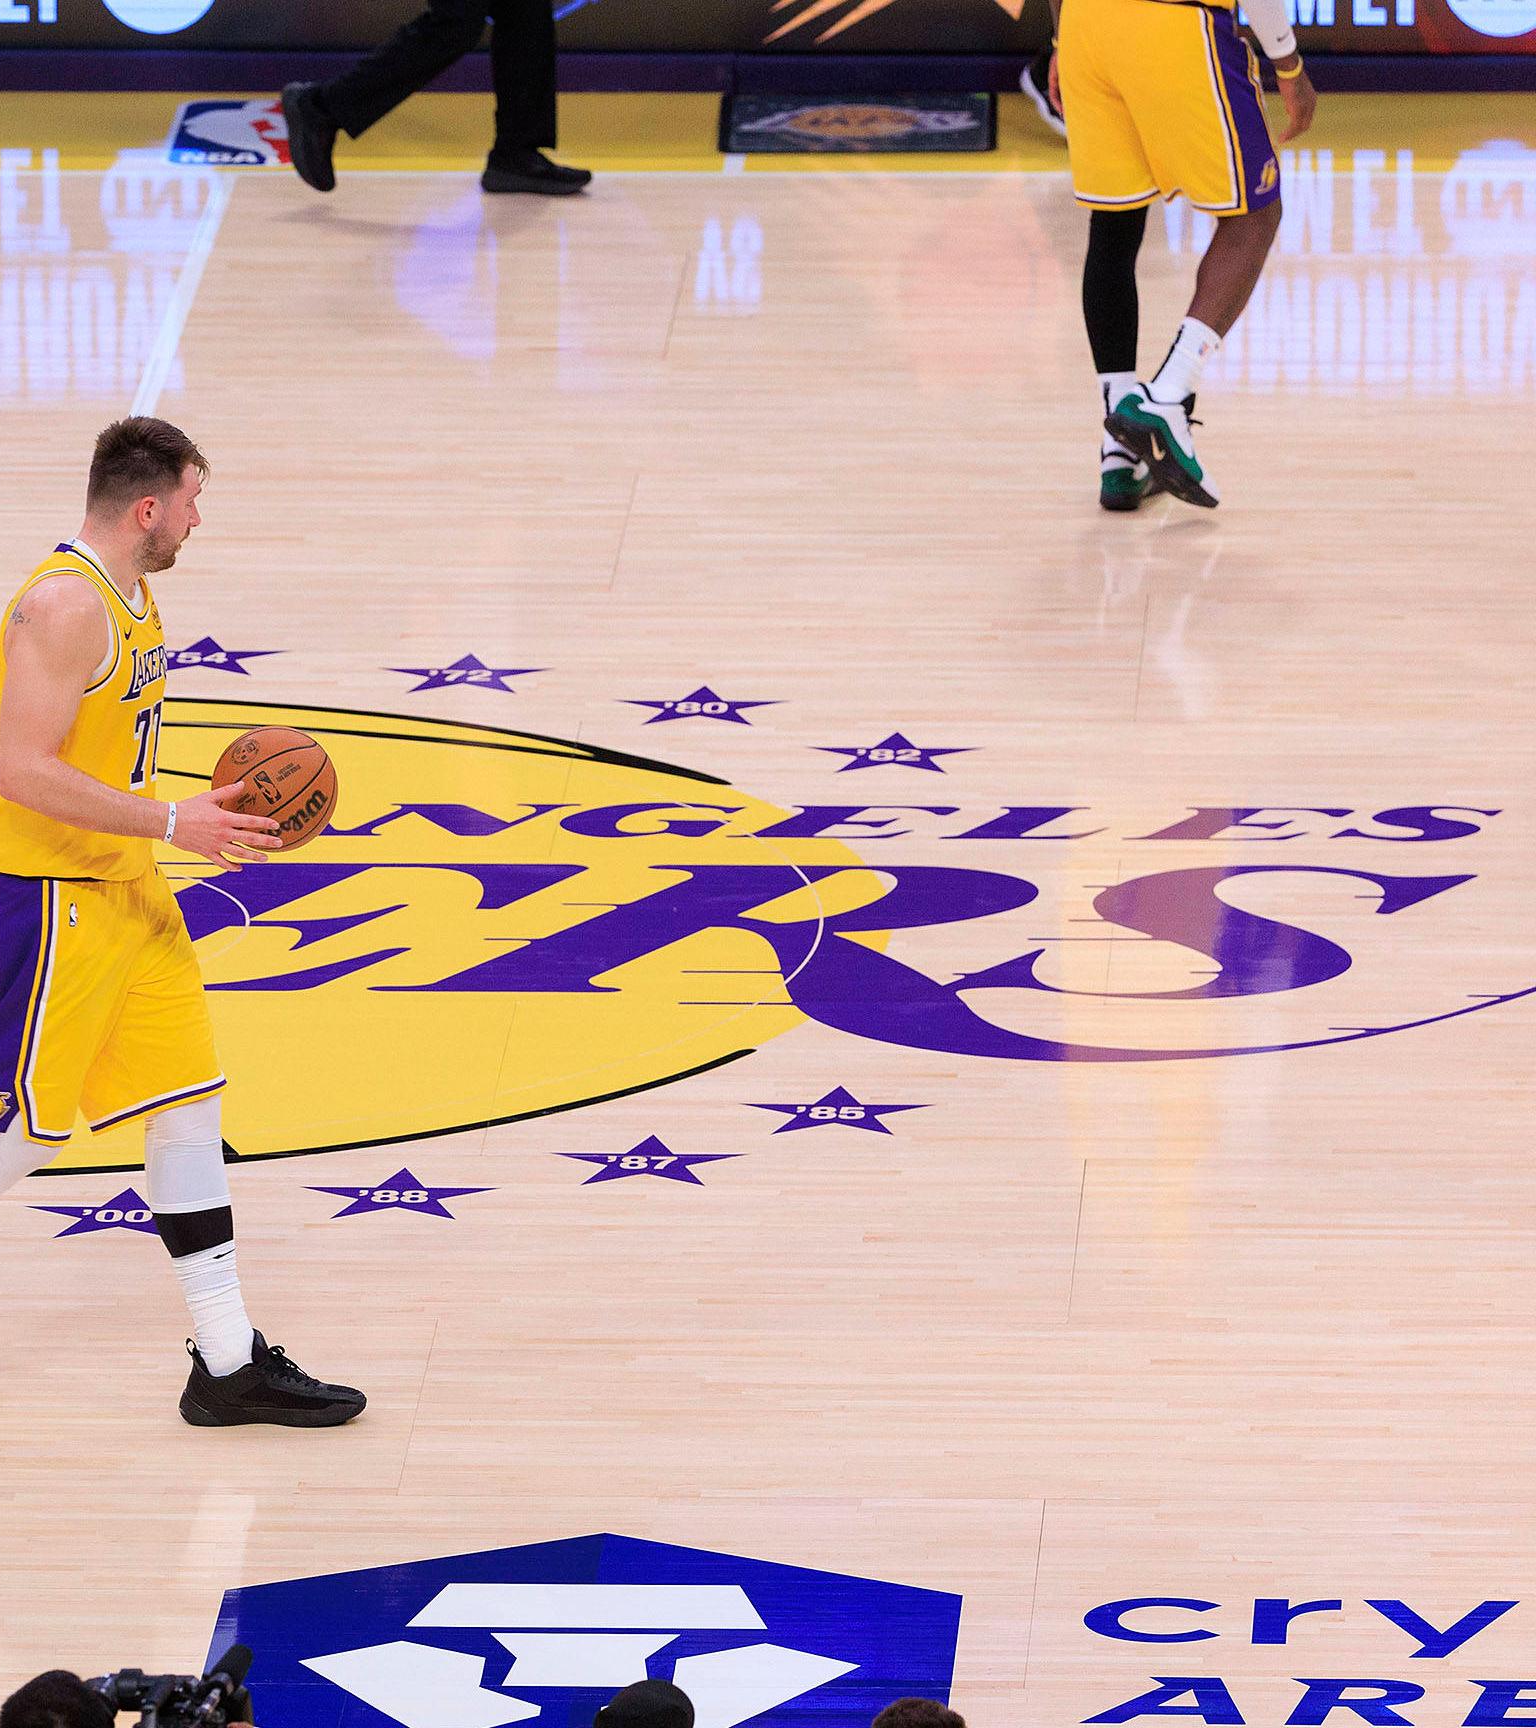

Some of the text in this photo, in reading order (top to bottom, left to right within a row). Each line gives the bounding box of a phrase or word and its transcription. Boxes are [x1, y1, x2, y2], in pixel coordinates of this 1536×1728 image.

[166, 651, 229, 664] '54
[428, 669, 494, 682] '72
[664, 701, 729, 715] '80
[857, 748, 922, 762] '82
[260, 789, 329, 838] Wilso
[319, 803, 1503, 842] NGELES
[796, 1106, 866, 1120] '85
[607, 1156, 678, 1170] '87
[358, 1189, 430, 1203] '88
[82, 1209, 154, 1223] '00
[1083, 1597, 1521, 1659] cry
[1078, 1676, 1536, 1727] ARE
